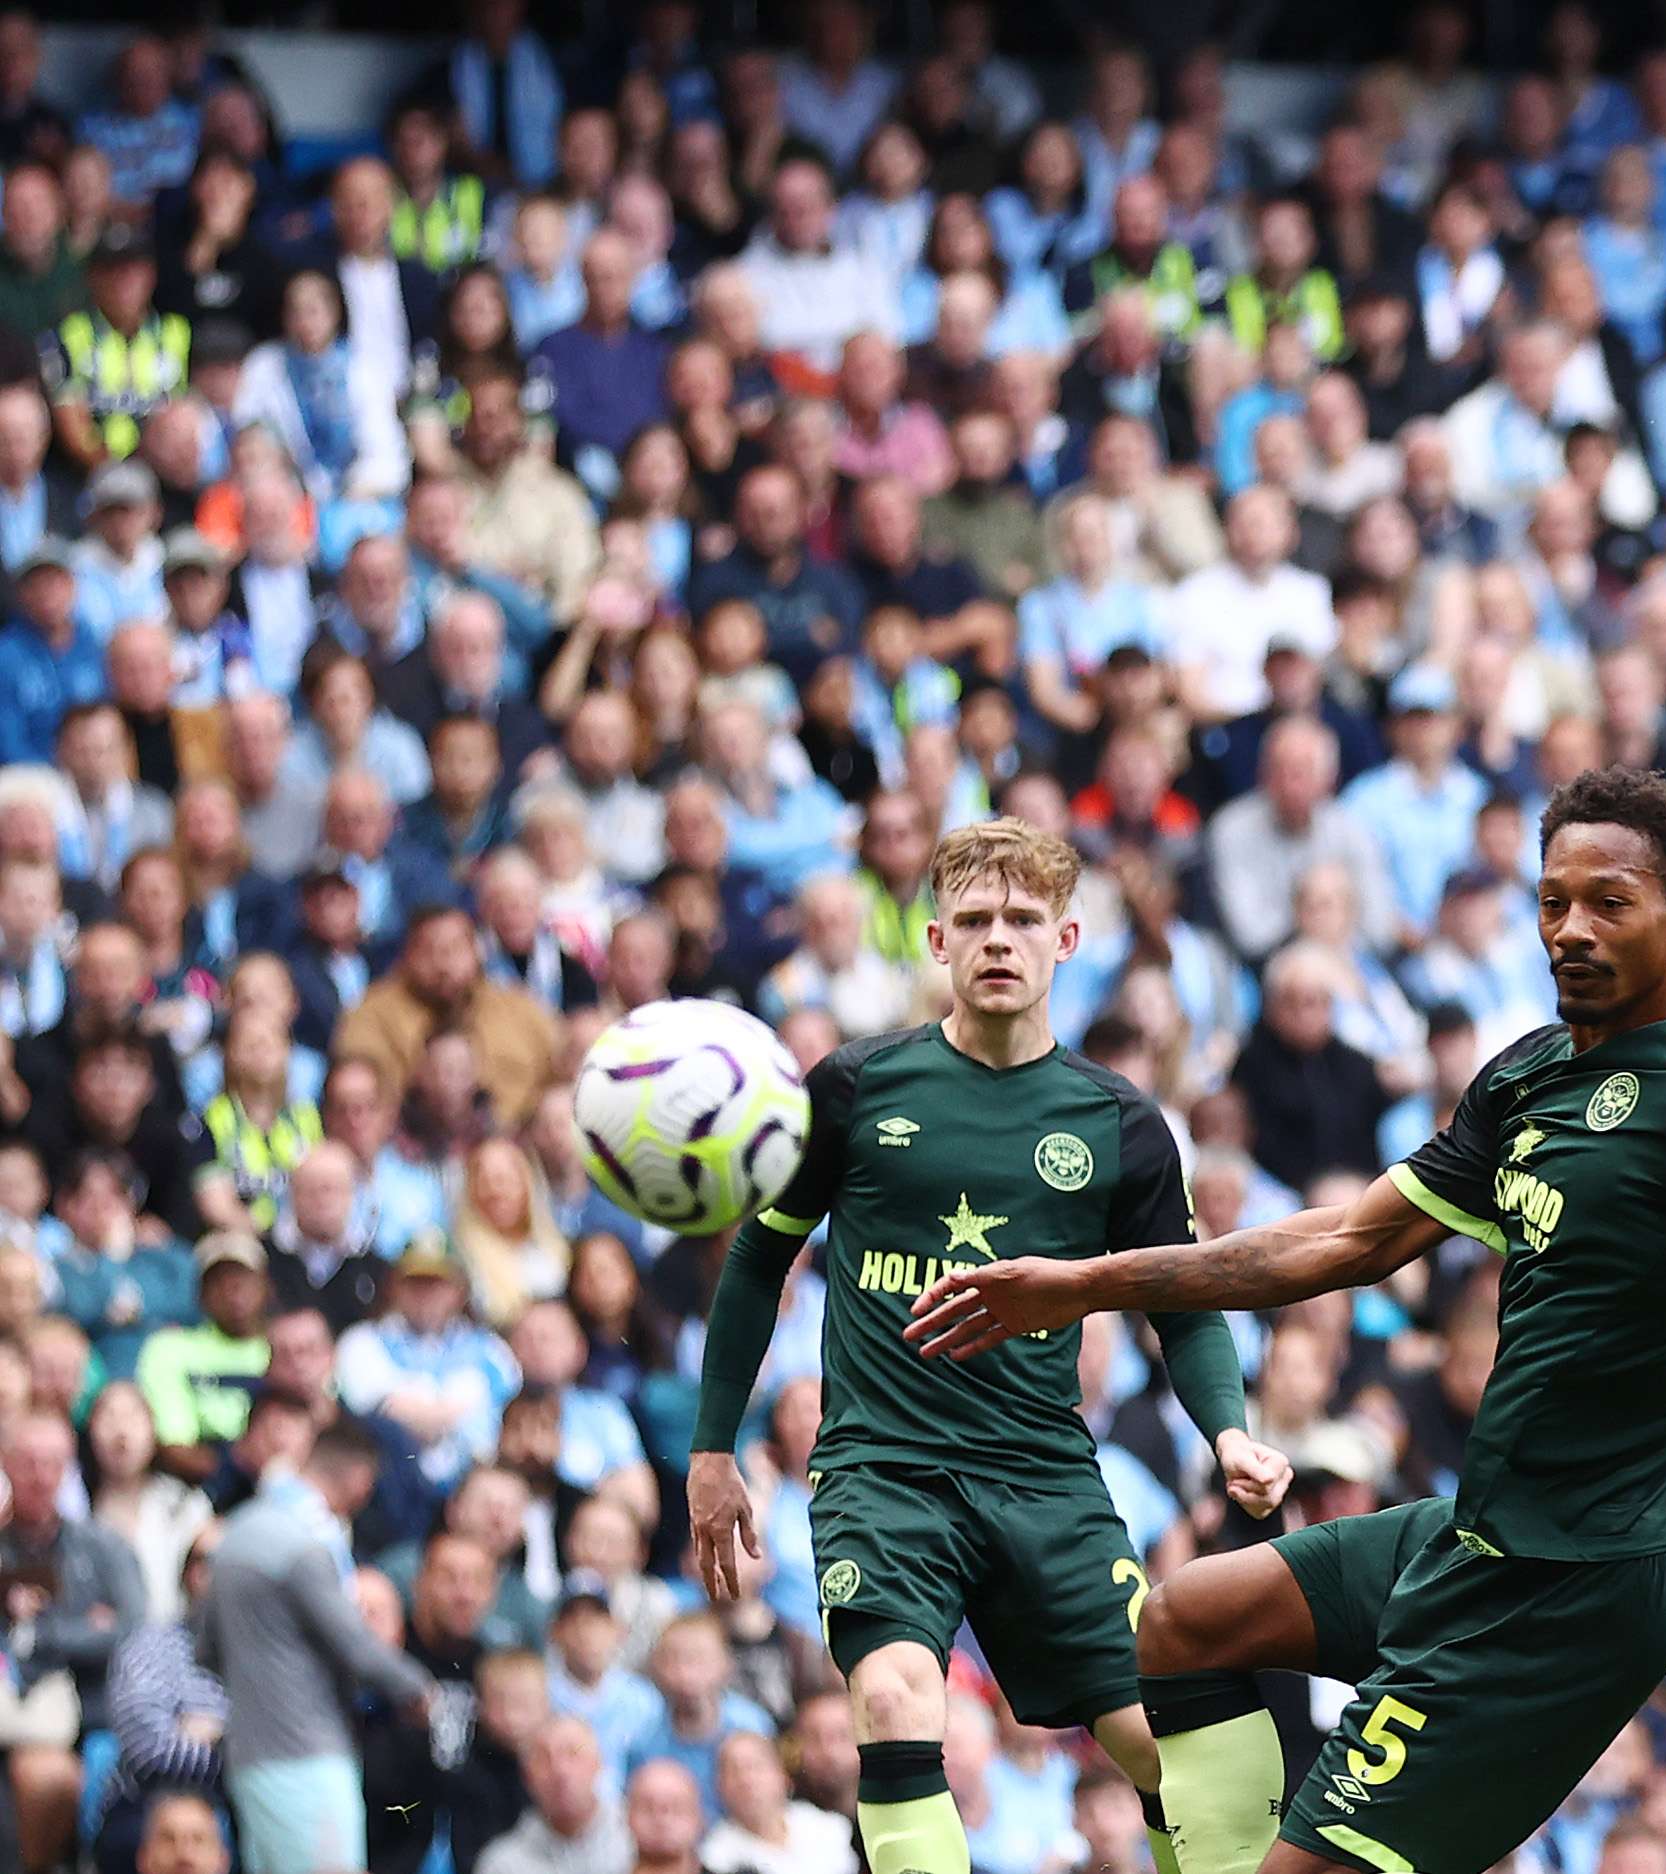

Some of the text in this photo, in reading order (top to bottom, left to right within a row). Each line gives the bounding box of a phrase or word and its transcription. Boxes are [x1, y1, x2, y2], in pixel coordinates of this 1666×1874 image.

[878, 1135, 911, 1147] umbro
[1347, 1694, 1427, 1785] 5
[1324, 1790, 1355, 1815] umbro
